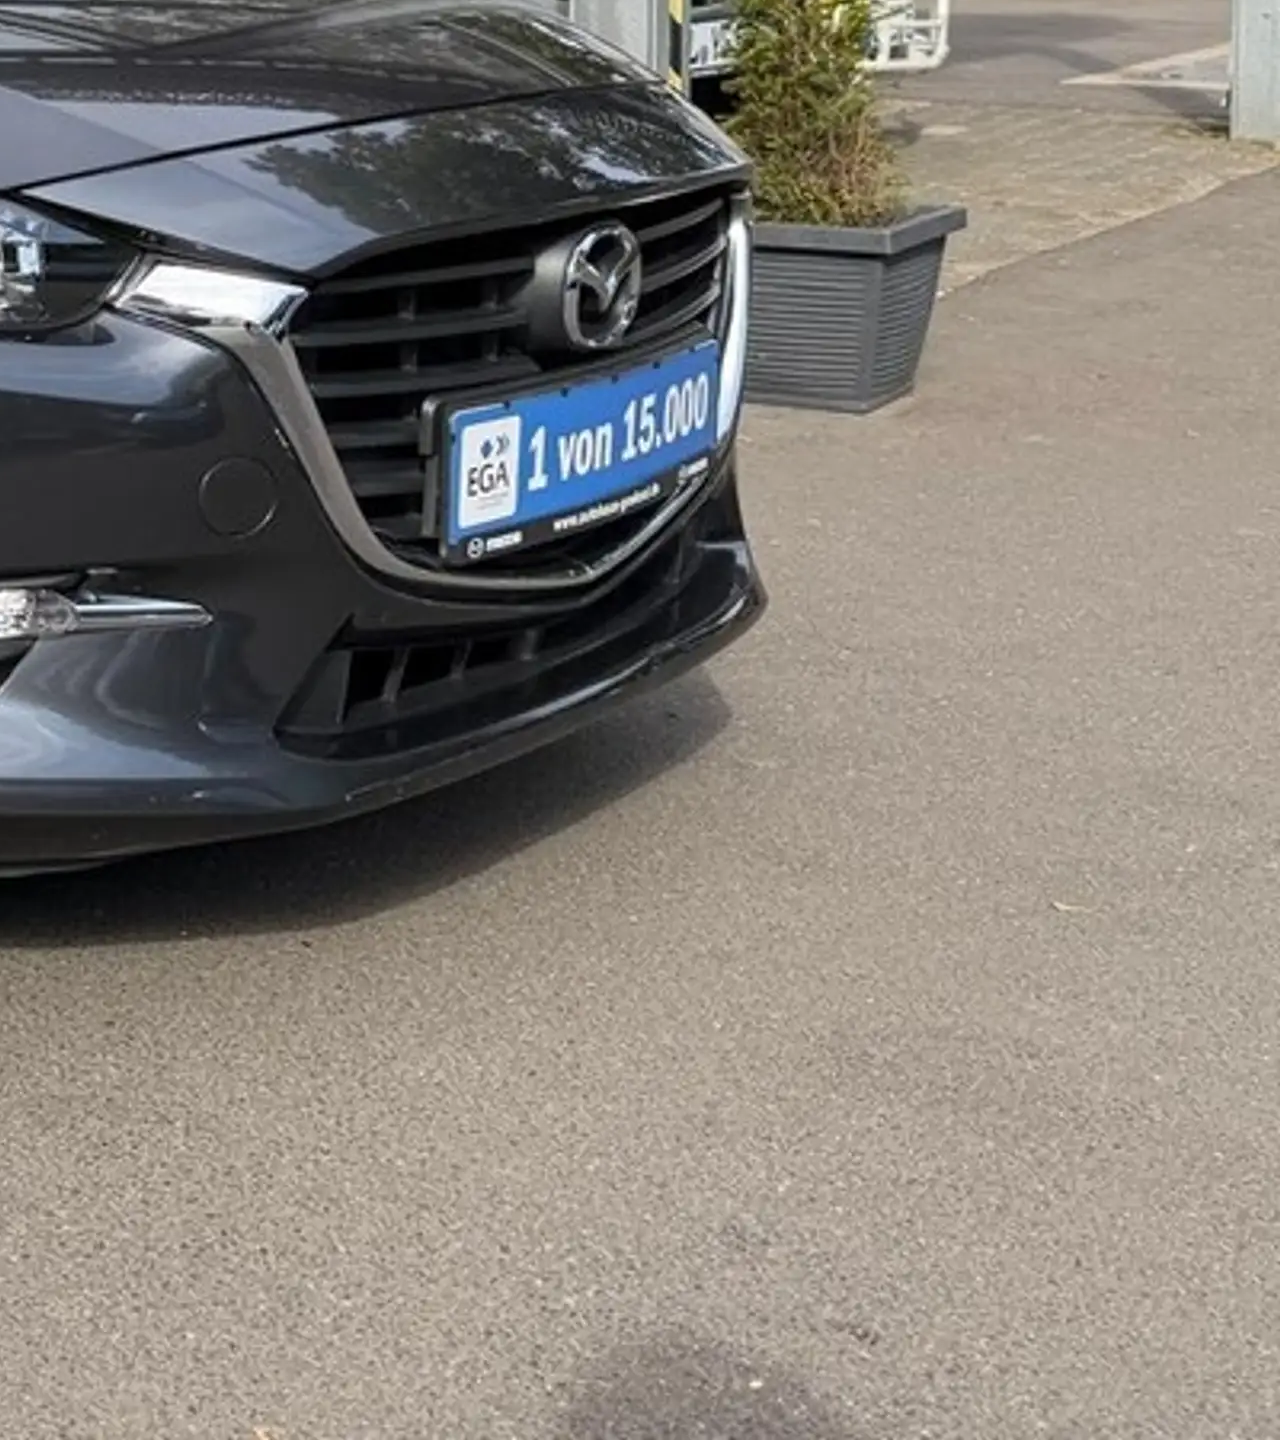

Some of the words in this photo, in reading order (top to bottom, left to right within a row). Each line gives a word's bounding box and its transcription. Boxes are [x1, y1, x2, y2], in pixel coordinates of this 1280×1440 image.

[528, 425, 548, 491] 1
[557, 422, 613, 481] von
[622, 372, 709, 461] 15.000
[466, 461, 510, 497] EGA
